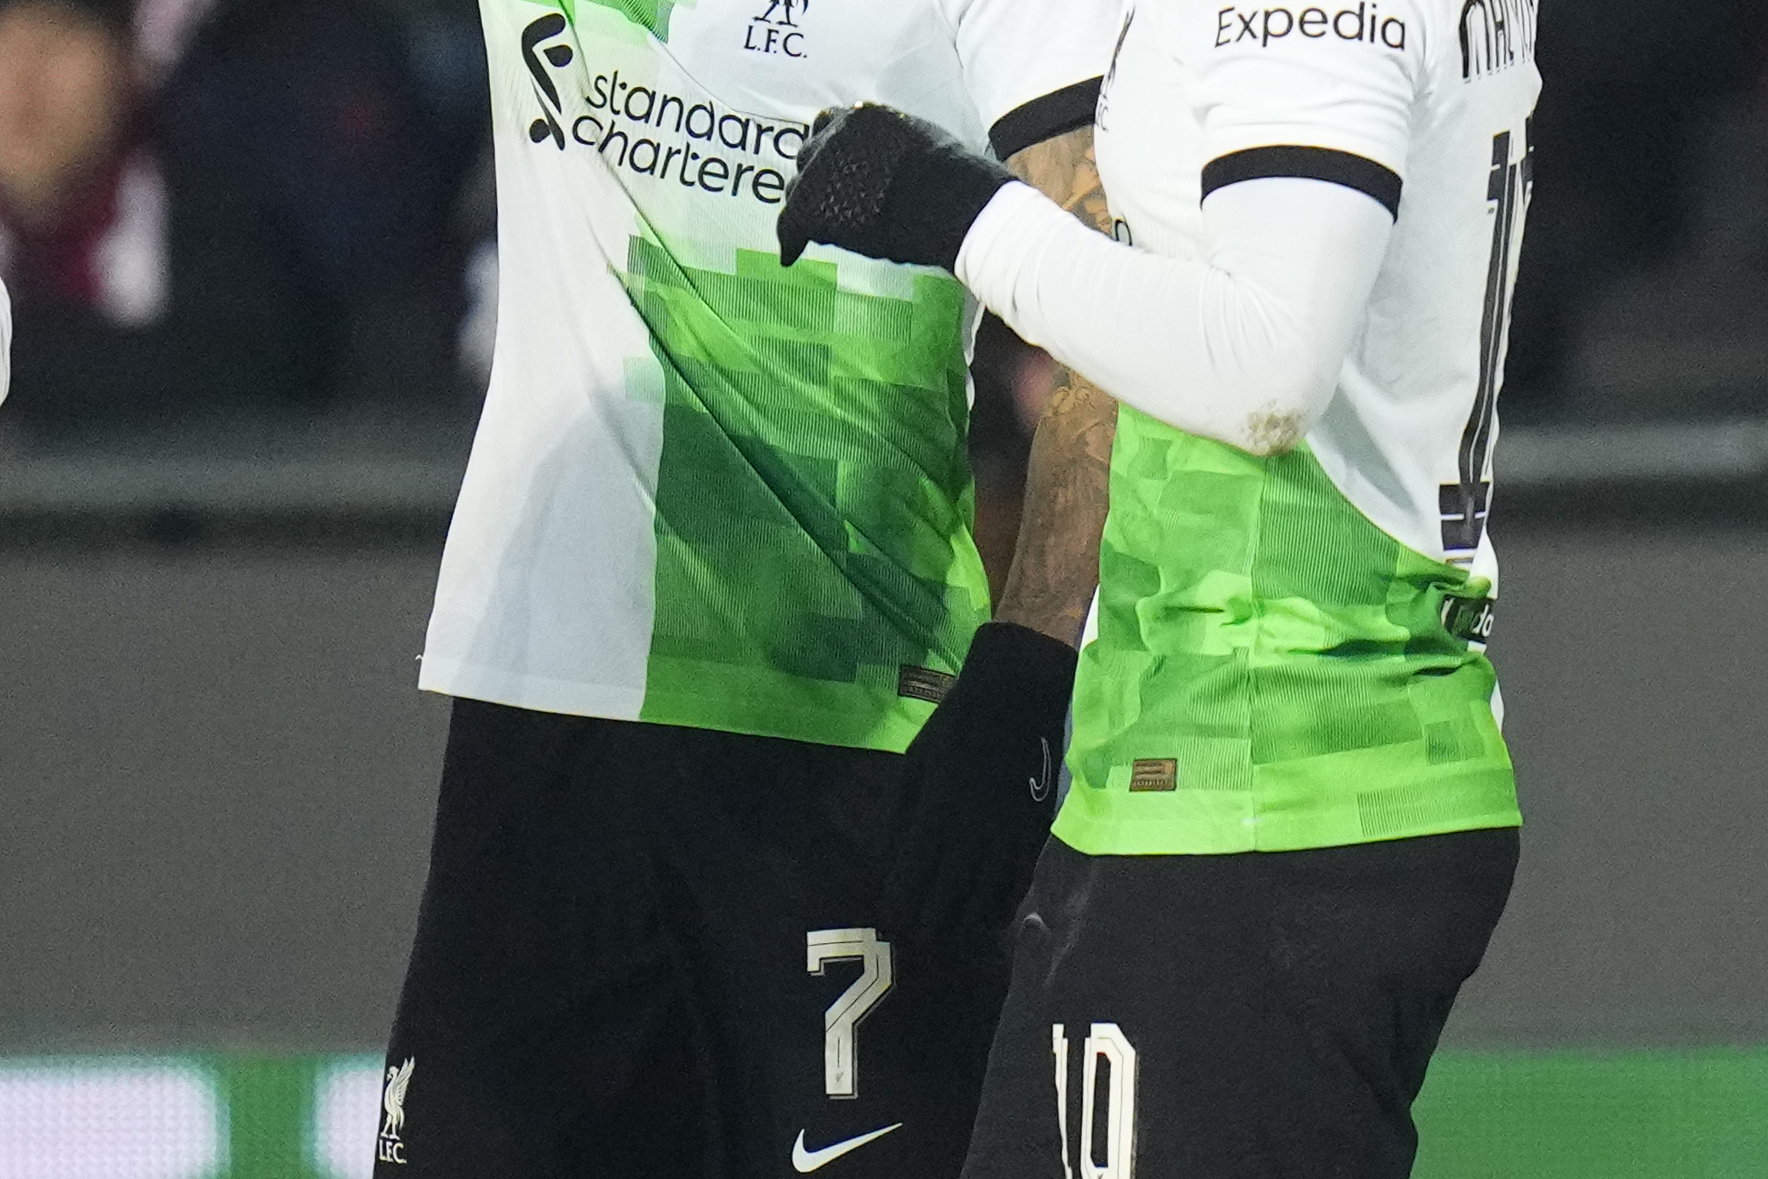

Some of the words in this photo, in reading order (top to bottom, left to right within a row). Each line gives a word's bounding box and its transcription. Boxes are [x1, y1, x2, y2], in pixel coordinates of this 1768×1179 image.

[743, 24, 808, 59] L.F.C.
[1214, 1, 1406, 52] Expedia
[572, 115, 786, 204] chartere
[586, 70, 811, 160] standard
[806, 927, 897, 1100] 7
